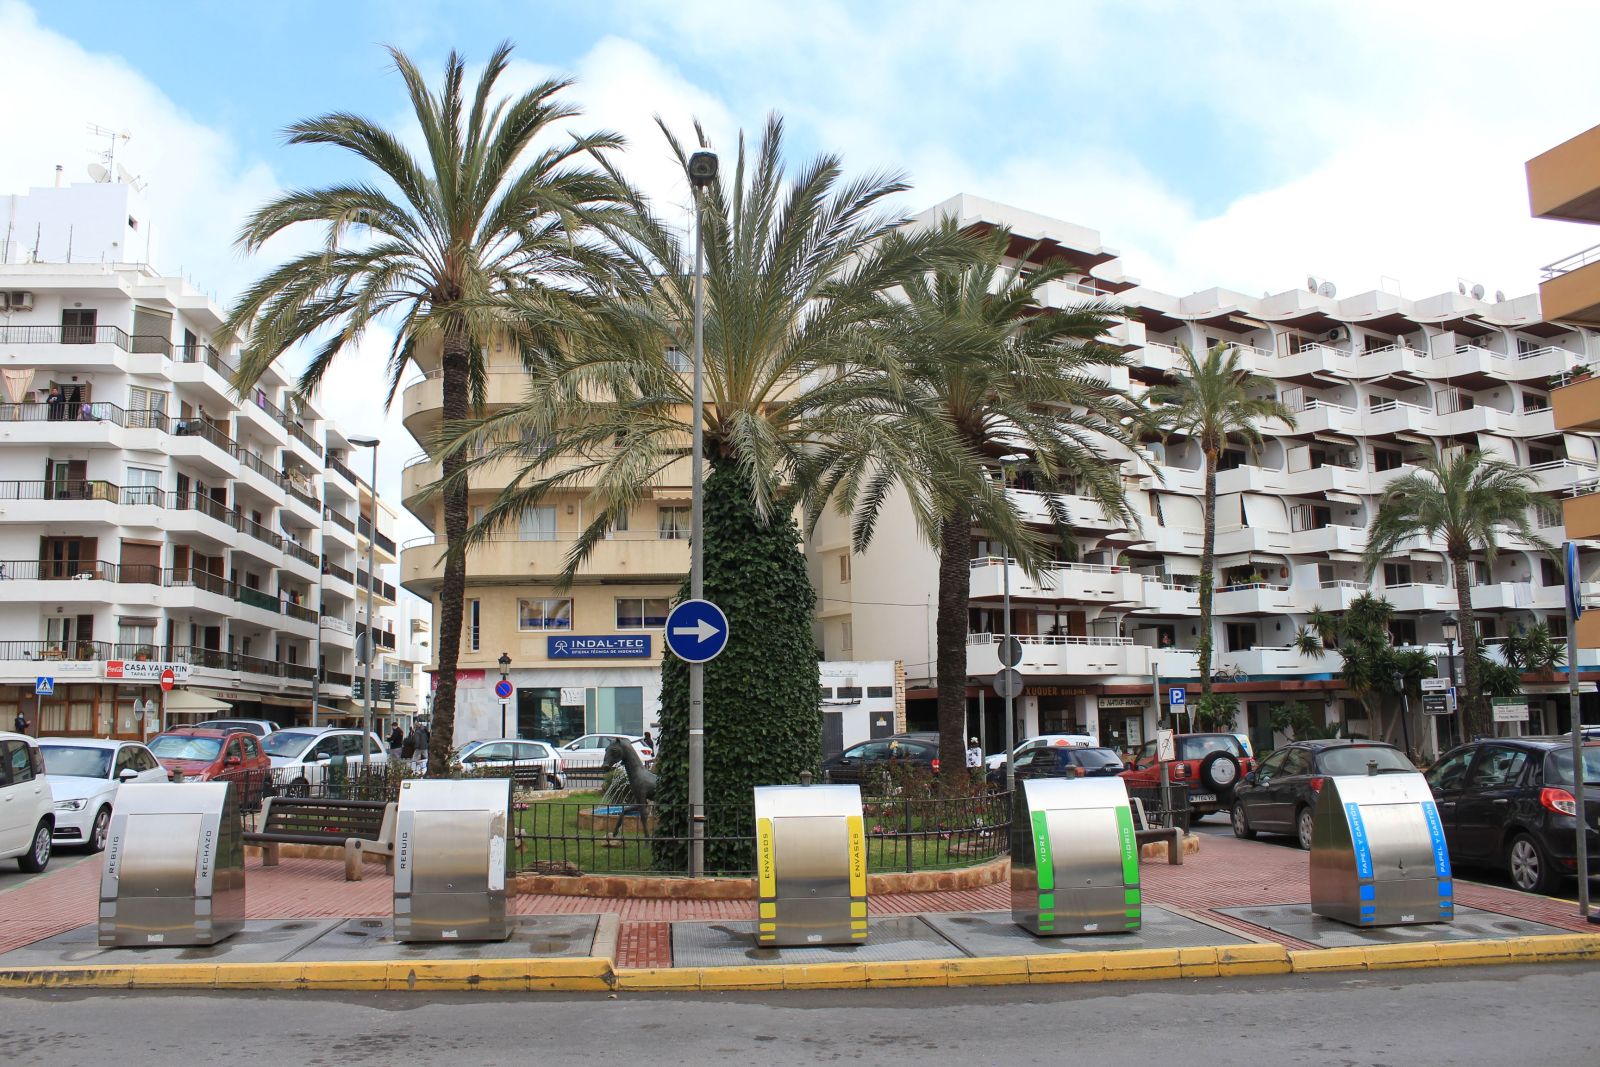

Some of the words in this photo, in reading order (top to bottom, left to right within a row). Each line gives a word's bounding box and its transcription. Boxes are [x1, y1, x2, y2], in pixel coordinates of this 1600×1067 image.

[572, 639, 644, 648] INDAL-TEC
[1172, 690, 1182, 704] P
[108, 836, 120, 874] REBUIG
[202, 830, 212, 878] RECHAZO
[1039, 834, 1047, 863] VIDRE
[1124, 827, 1132, 860] VIDRIO
[1360, 846, 1368, 874] PAPEL
[1437, 846, 1446, 872] PAPEL
